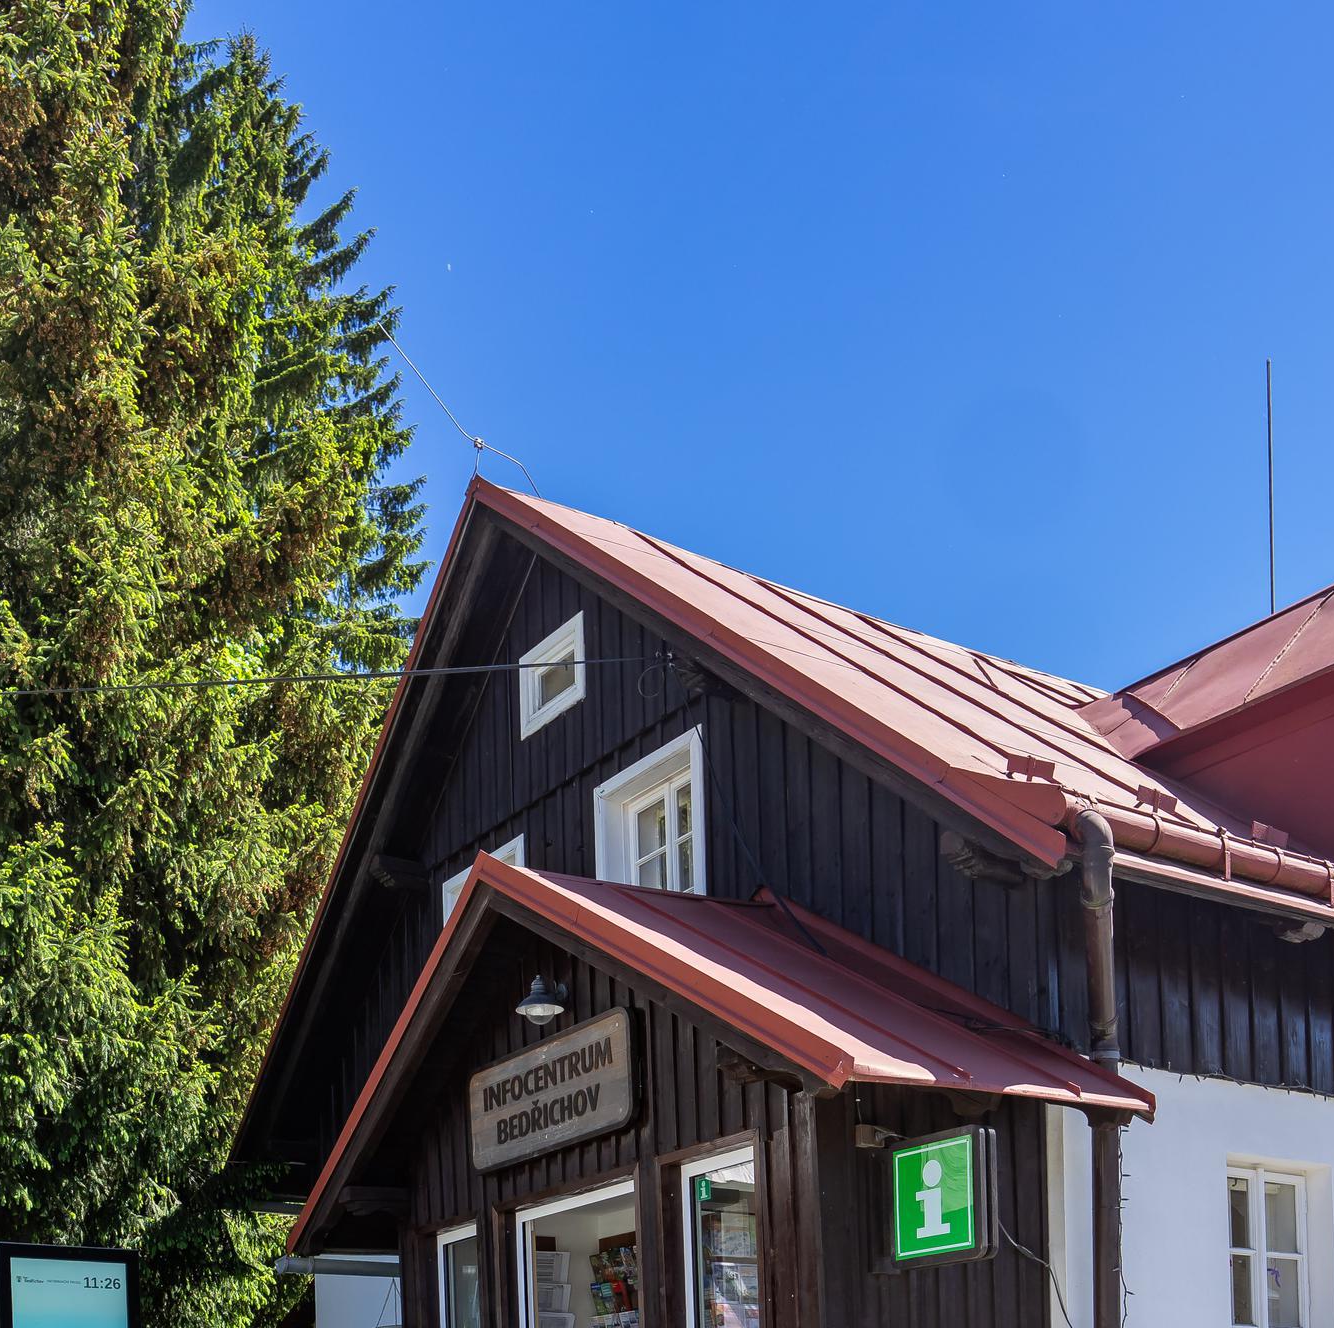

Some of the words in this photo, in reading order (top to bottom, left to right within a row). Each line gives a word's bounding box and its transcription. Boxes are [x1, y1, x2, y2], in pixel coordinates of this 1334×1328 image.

[482, 1036, 613, 1113] INFOCENTRUM
[496, 1083, 601, 1145] BEDŘICHOV
[83, 1277, 121, 1289] 11:26
